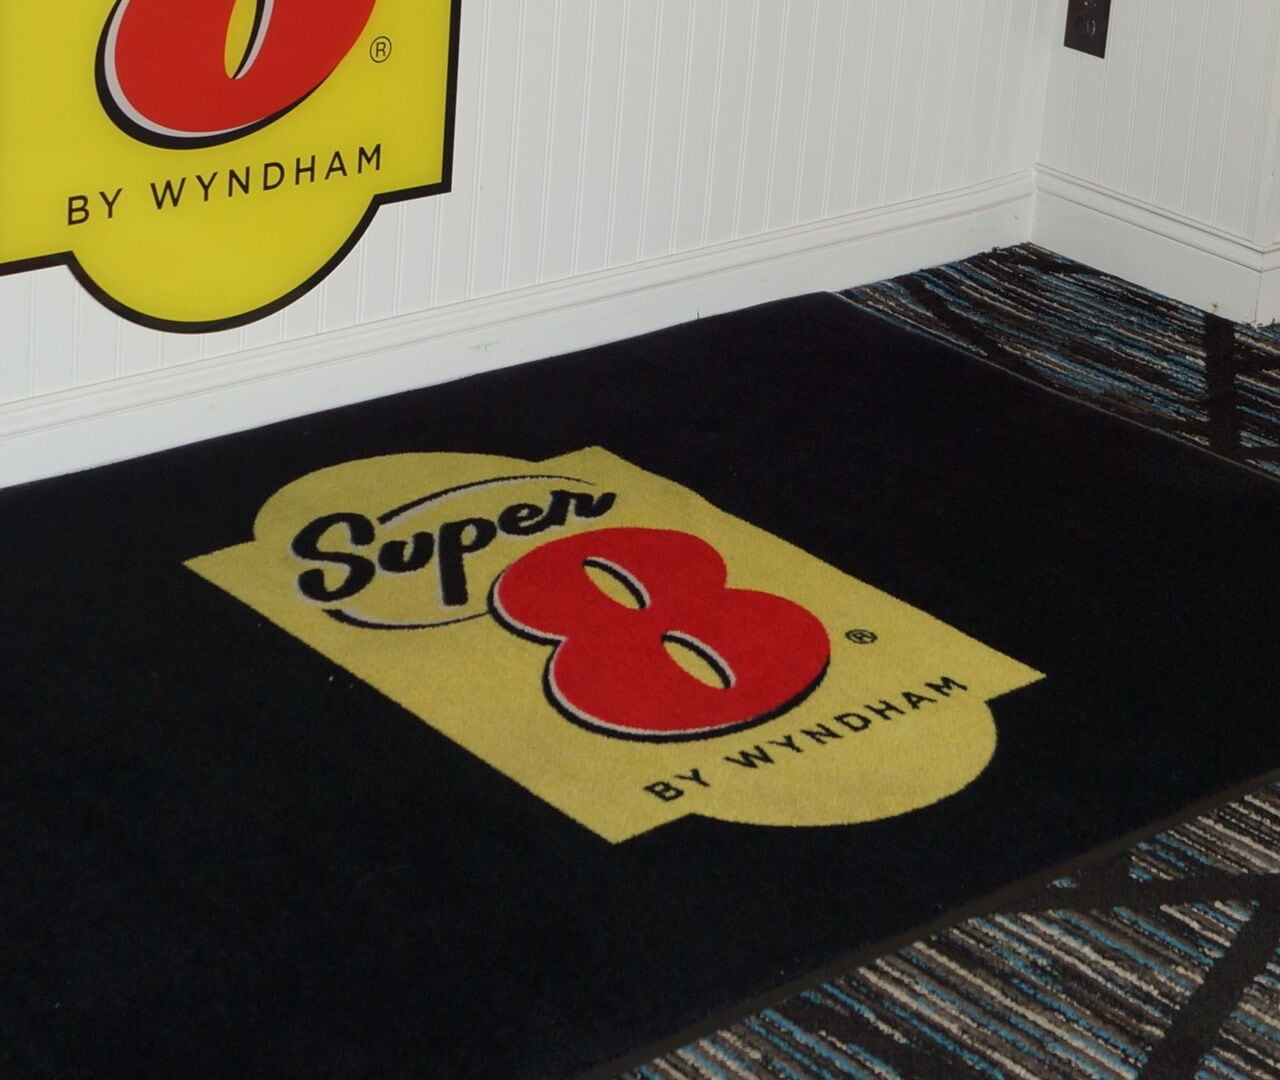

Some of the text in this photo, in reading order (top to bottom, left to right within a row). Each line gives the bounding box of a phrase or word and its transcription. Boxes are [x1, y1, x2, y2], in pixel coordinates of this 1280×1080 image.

[66, 143, 383, 227] BY WYNDHAM
[290, 486, 617, 607] Super
[487, 527, 832, 743] 8
[643, 676, 968, 804] BY WYNDHAM
